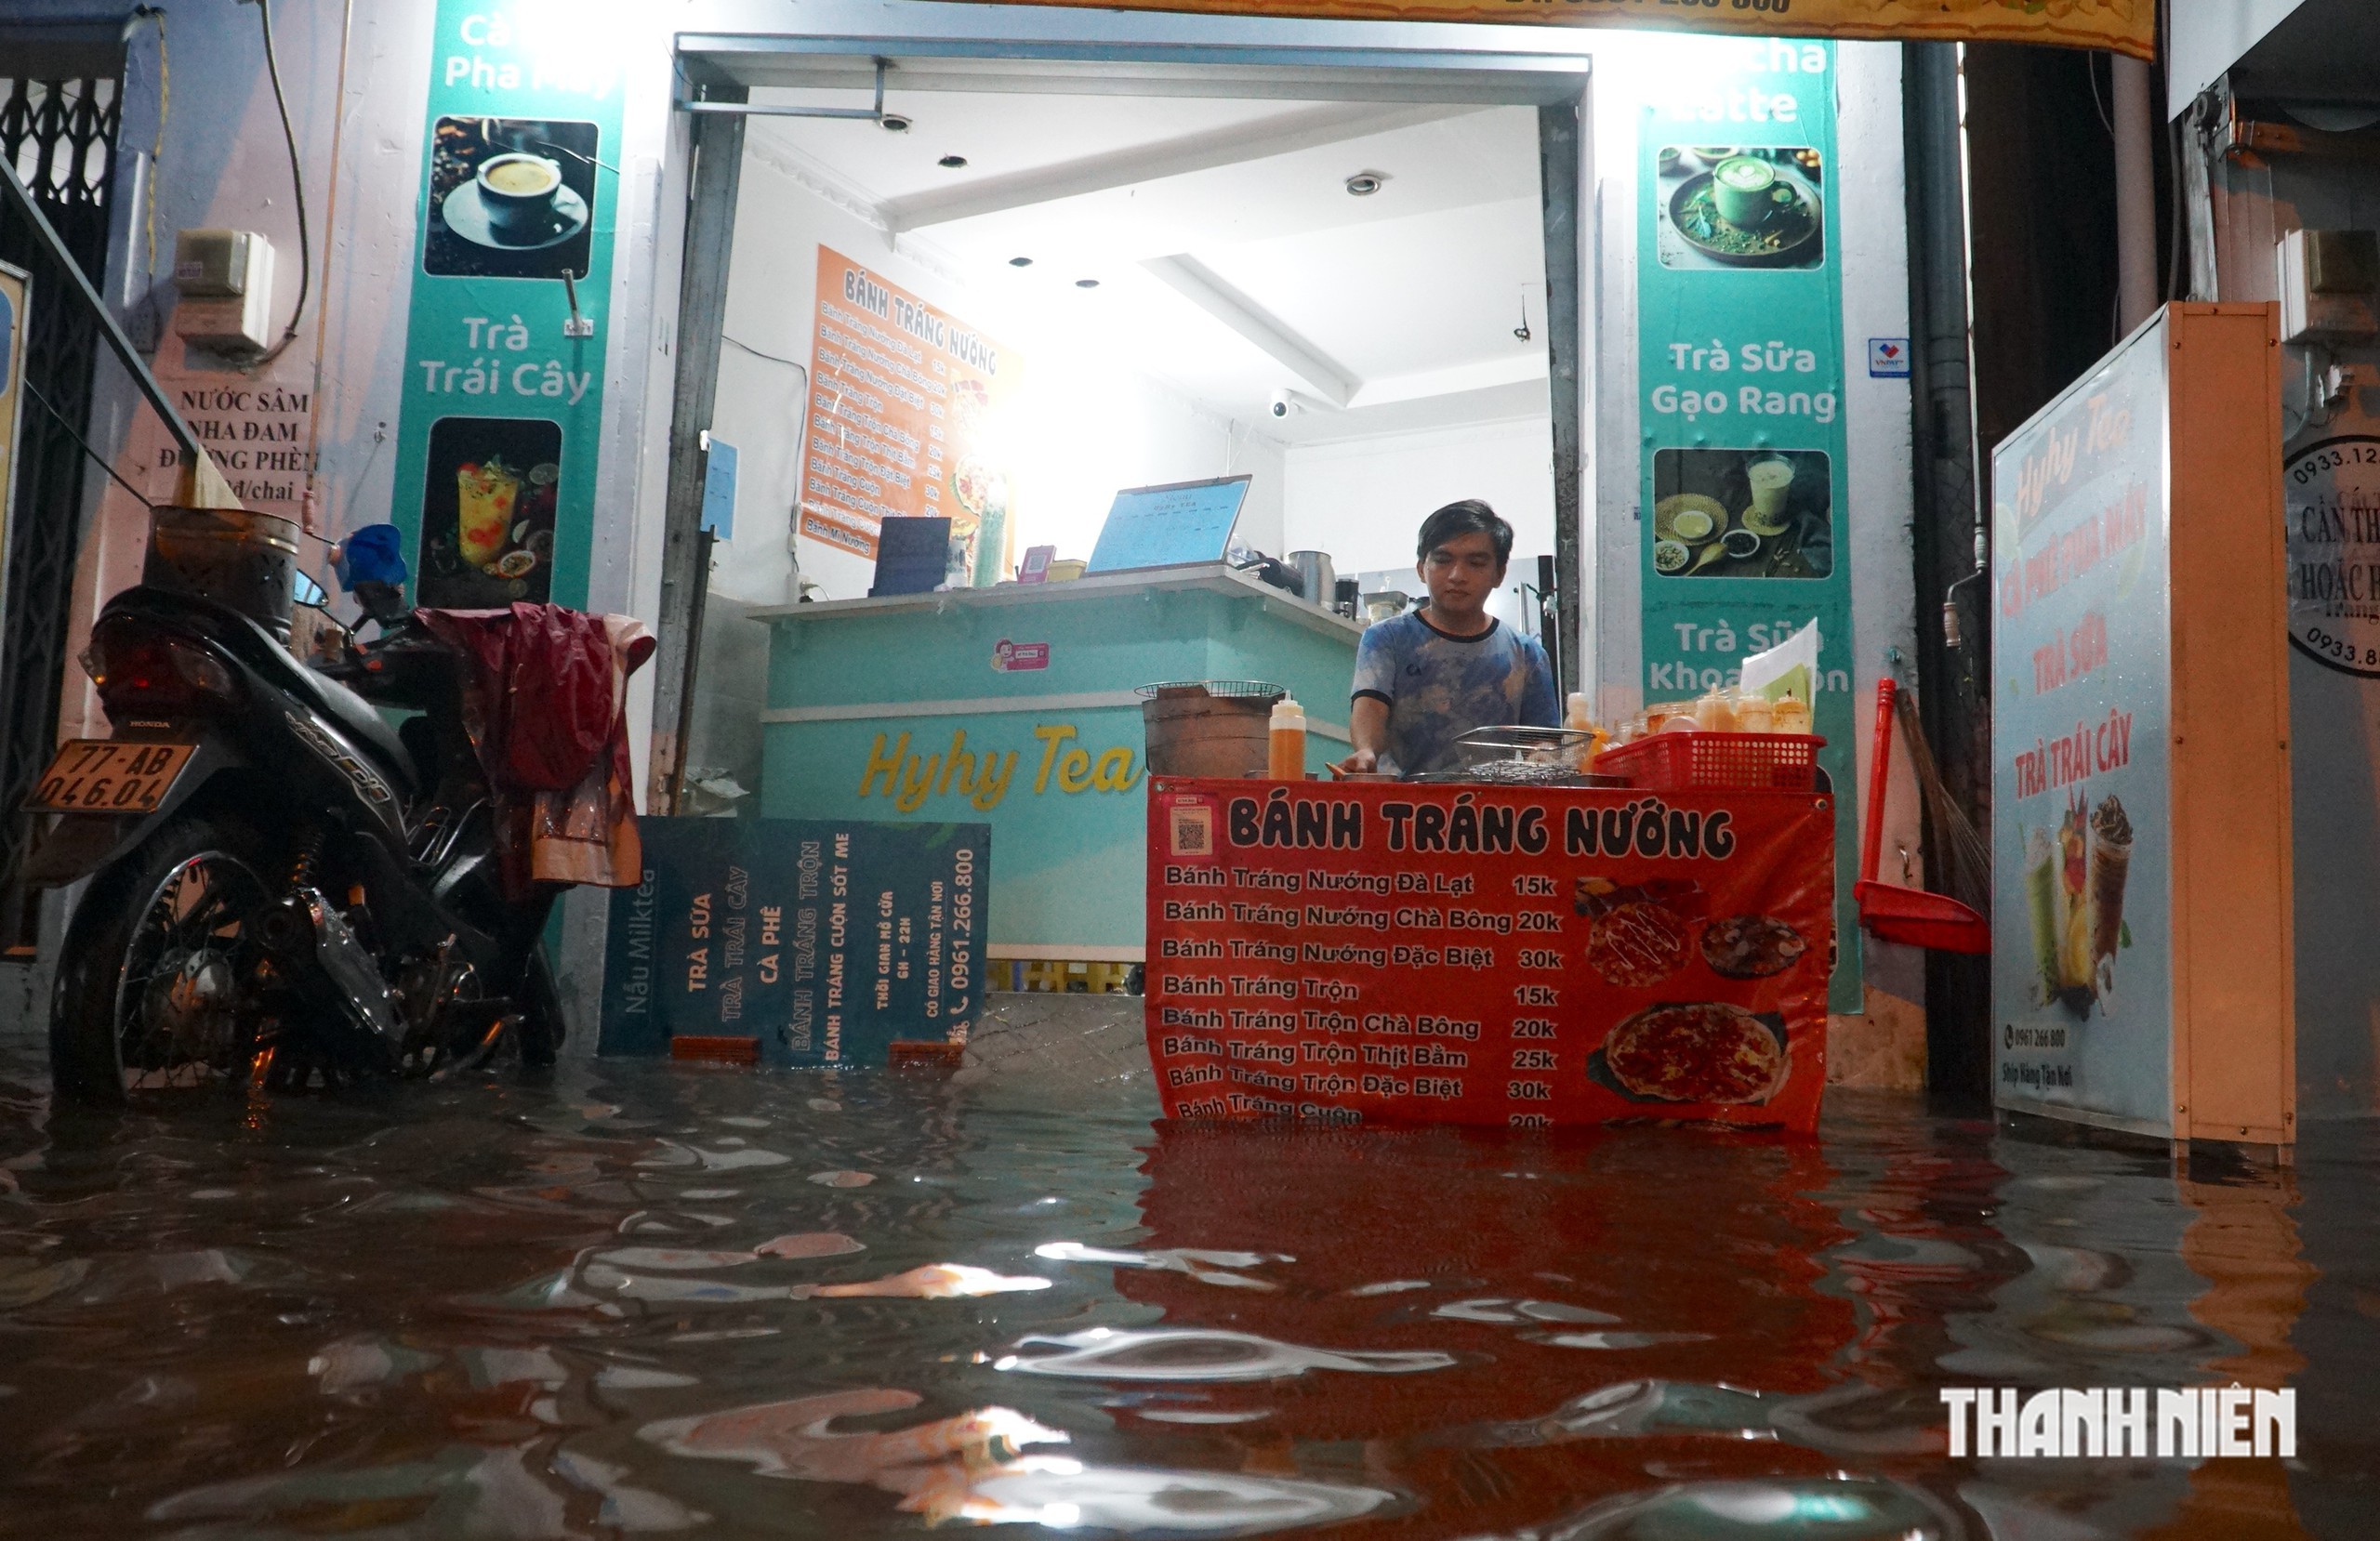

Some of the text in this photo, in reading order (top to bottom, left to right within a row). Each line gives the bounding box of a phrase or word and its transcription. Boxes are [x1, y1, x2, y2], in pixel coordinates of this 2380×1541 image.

[444, 55, 521, 89] Pha
[462, 316, 528, 350] Trà
[845, 269, 997, 376] BÁNH TRÁNG NƯỚNG
[1669, 339, 1817, 373] Trà Sữa
[180, 385, 310, 414] NƯỚC SÂM
[421, 358, 590, 405] Trái Cây
[1651, 385, 1837, 424] Gạo Rang
[188, 420, 298, 442] NHA ĐAM
[2085, 392, 2130, 454] Tea
[160, 448, 247, 470] ĐNG
[2294, 447, 2380, 484] 0933.12
[226, 479, 294, 501] đ/chai
[807, 519, 828, 536] Bánh
[841, 533, 870, 555] Nướng
[1674, 619, 1736, 652] Trà
[2307, 626, 2380, 666] 0933.8
[1649, 661, 1741, 691] Khoa
[2033, 627, 2067, 695] TRÀ
[129, 720, 170, 729] HONDA
[68, 745, 175, 776] 77-AB
[857, 722, 1144, 813] Hyhy Tea
[2016, 708, 2133, 800] TRÀ TRÁI CÂY
[37, 776, 162, 807] 046.04
[1228, 786, 1737, 861] BÁNH TRÁNG NƯỚNG
[1166, 865, 1557, 899] Bánh Tráng Nướng Đà Lạt 15k
[628, 868, 655, 960] Milktea
[898, 917, 911, 944] 22H
[951, 849, 973, 990] 0961.266.800
[1165, 901, 1563, 935] Bánh Tráng Nướng Chà Bông 20k
[686, 892, 712, 993] TRÀ SỮA
[720, 865, 749, 1022] TRÀ TRÁI CÂY
[757, 905, 781, 984] CÀ PHÊ
[789, 841, 823, 1052] BÁNH TRÁNG TRỘN
[825, 833, 850, 1061] BÁNH TRÁNG CUỘN SỐT ME
[875, 891, 893, 1010] THỜI GIAN MỞ CỬA
[925, 881, 945, 1018] CÓ GIAO HÀNG TẬN NƠI
[1162, 938, 1563, 971] Bánh Tráng Nướng Đặc Biệt 30k
[1163, 974, 1558, 1007] Bánh Tráng Trộn 15k
[1162, 1007, 1557, 1041] Bánh Tráng Trộn Chà Bông 20k
[1163, 1035, 1558, 1070] Bánh Tráng Trộn Thịt Bằm 25k
[1169, 1063, 1552, 1100] Bánh Tráng Trộn Đặc Biệt 30k
[1177, 1096, 1226, 1118] Bánh
[1227, 1092, 1295, 1116] Tráng
